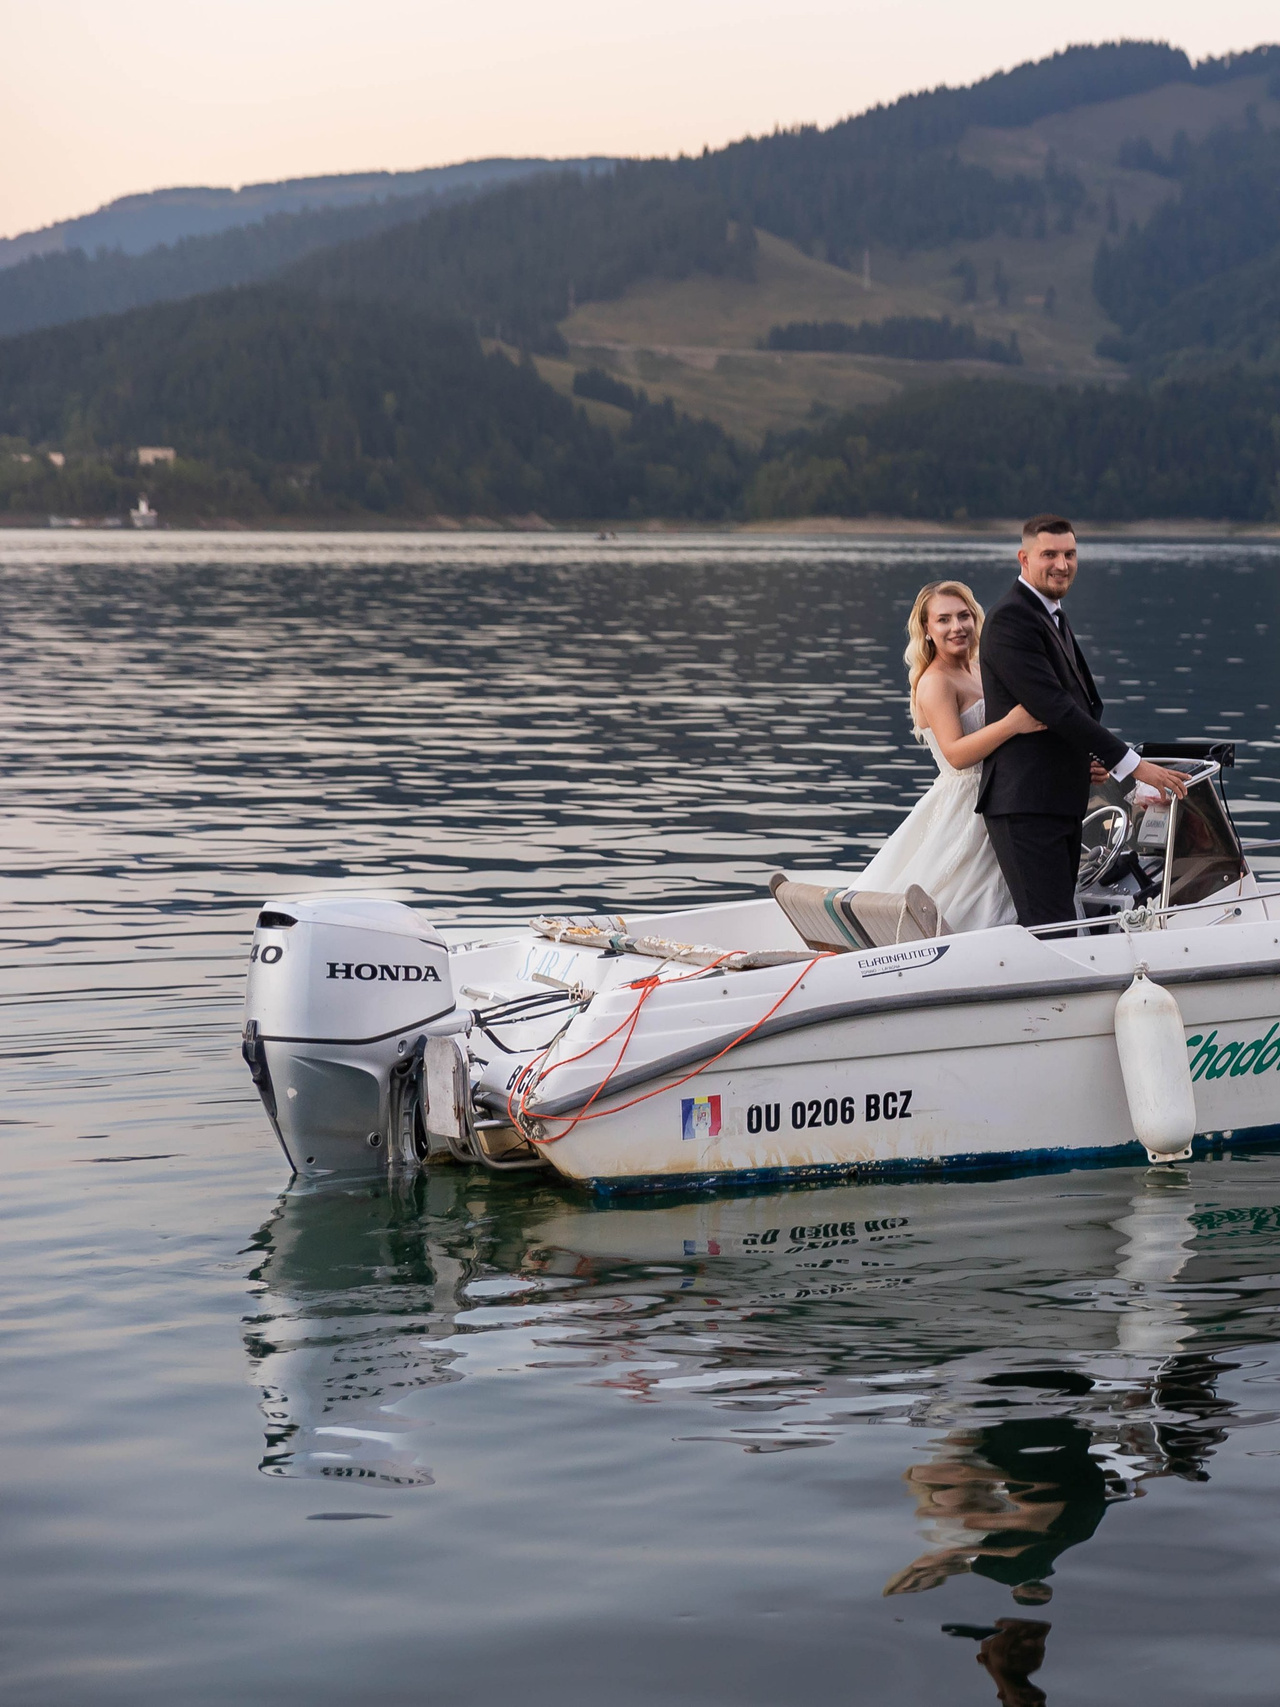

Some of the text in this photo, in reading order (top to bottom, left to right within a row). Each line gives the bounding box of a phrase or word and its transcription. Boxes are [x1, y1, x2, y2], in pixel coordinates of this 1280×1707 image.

[250, 944, 283, 964] 40
[516, 947, 578, 982] SARA
[858, 947, 937, 968] EURONAUTICA
[326, 962, 442, 982] HONDA
[746, 1103, 781, 1134] OU
[791, 1096, 855, 1130] 0206
[865, 1089, 913, 1122] BCZ
